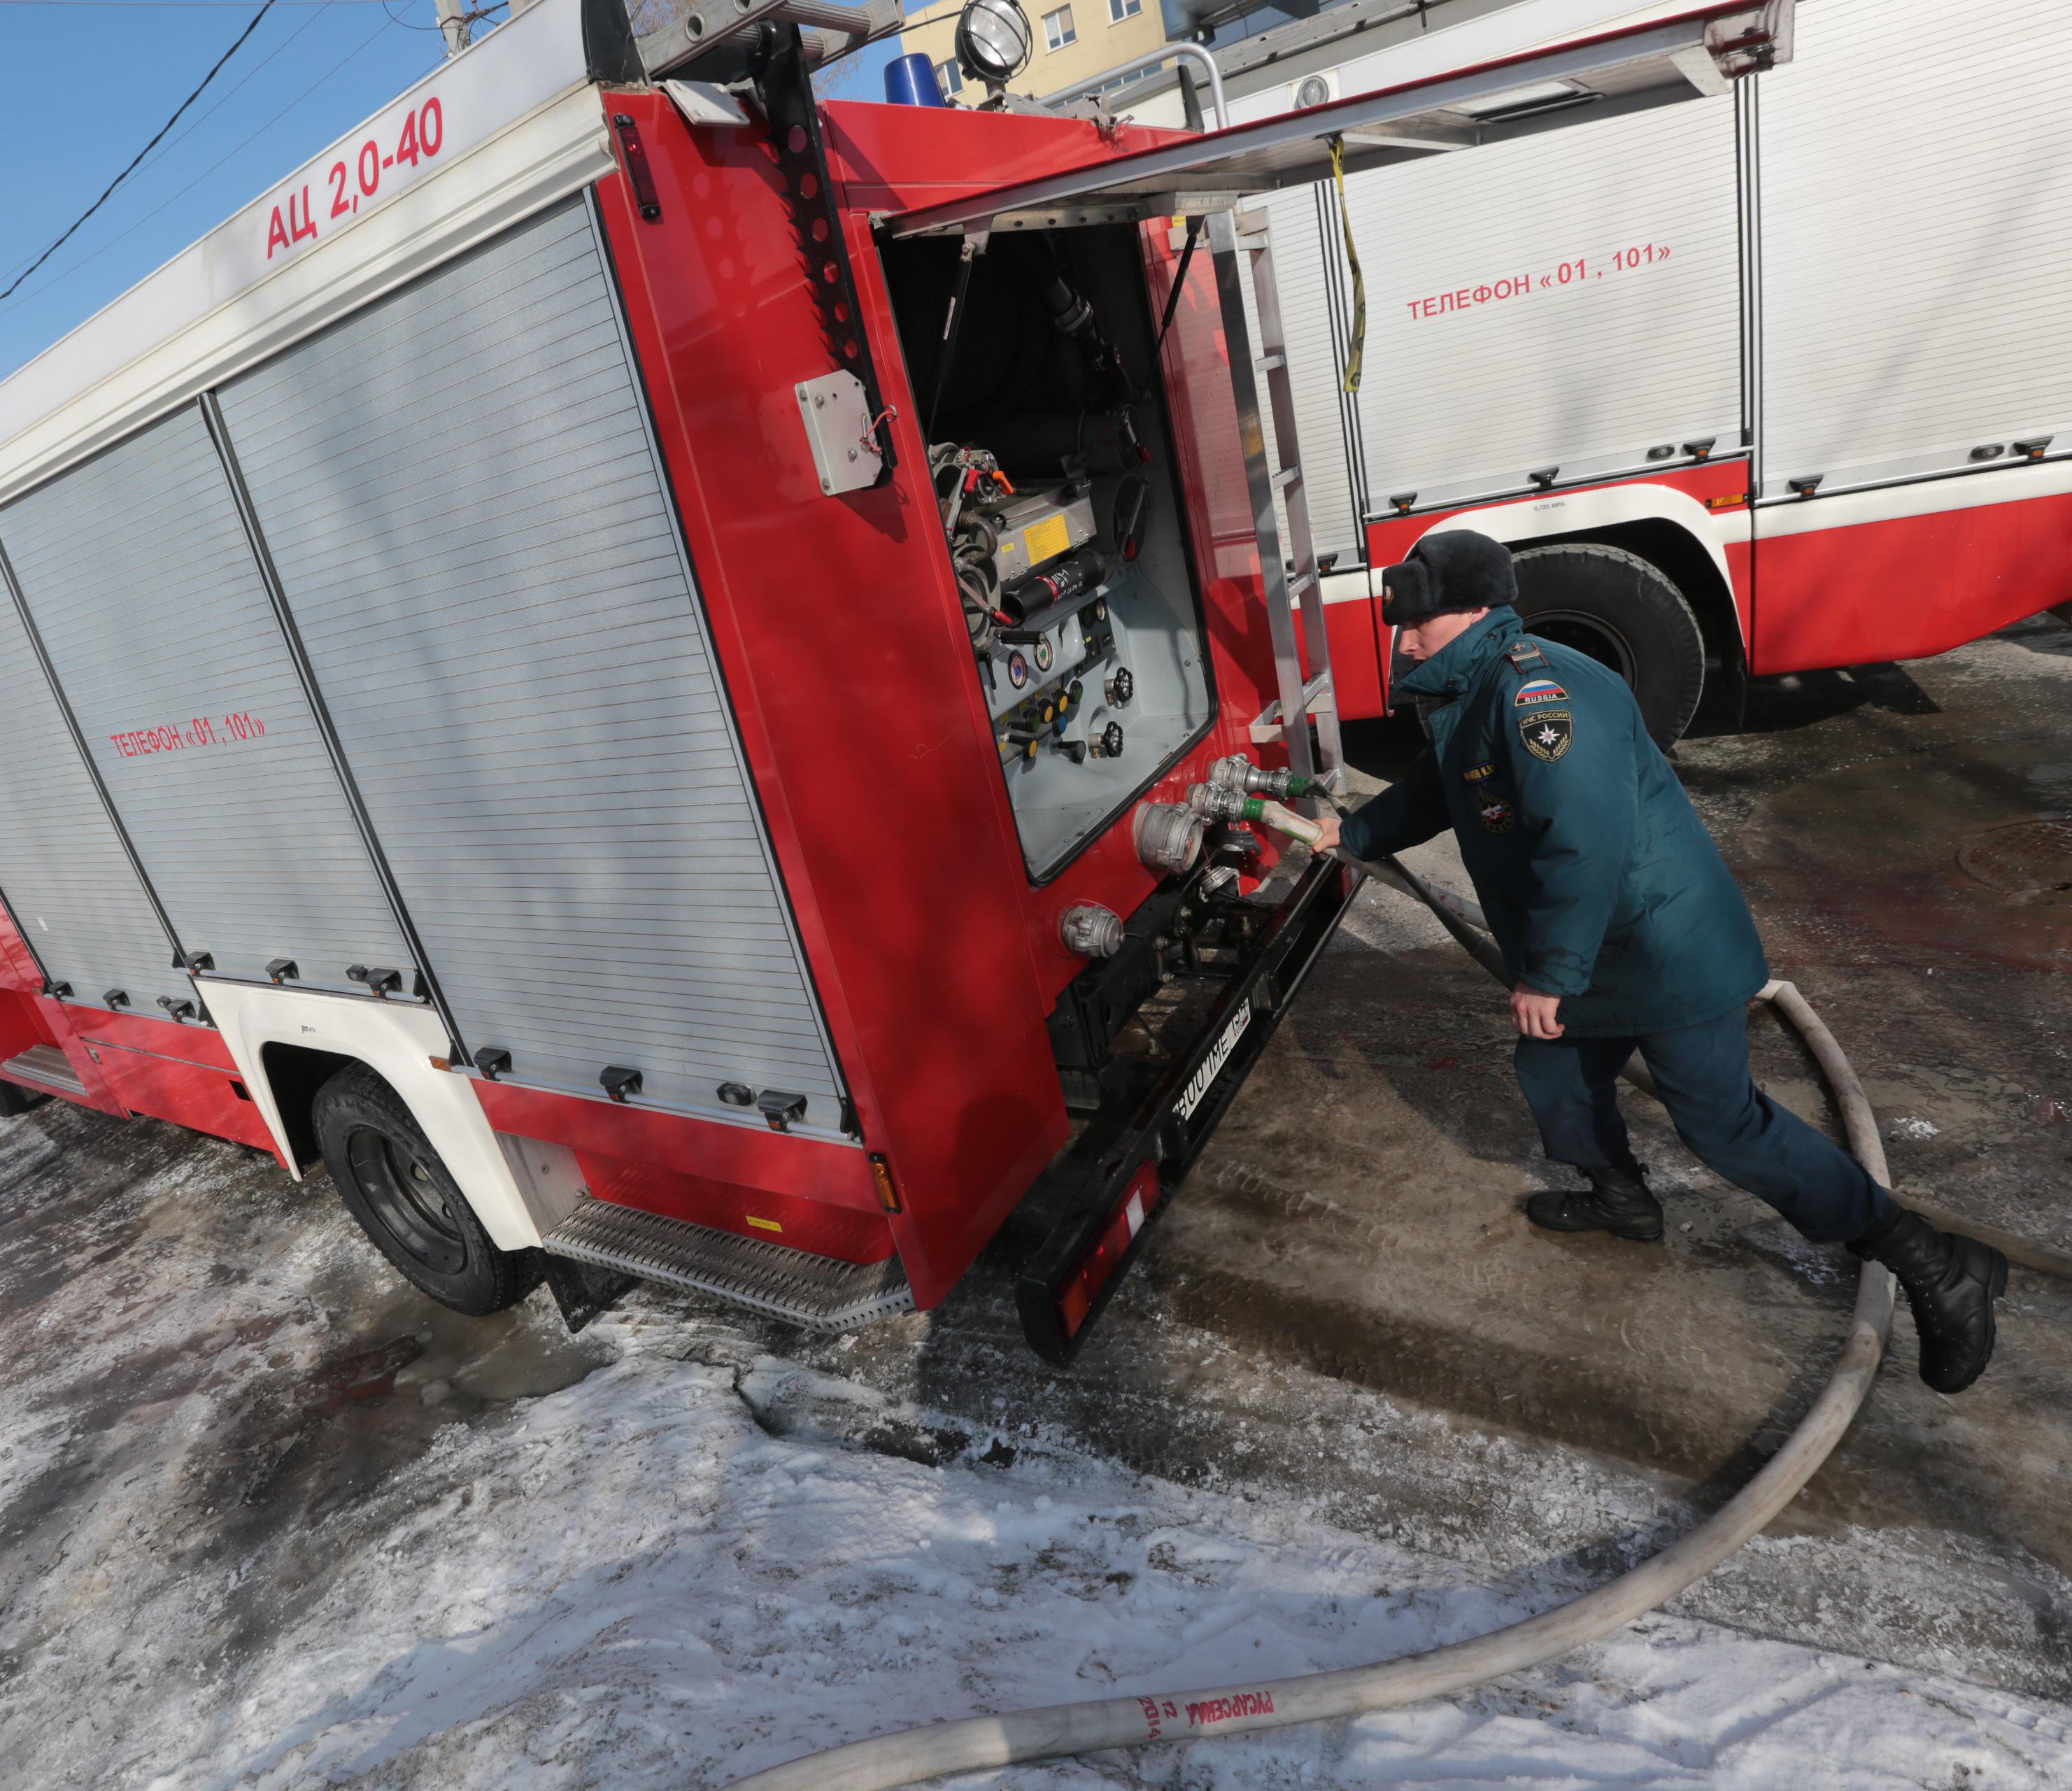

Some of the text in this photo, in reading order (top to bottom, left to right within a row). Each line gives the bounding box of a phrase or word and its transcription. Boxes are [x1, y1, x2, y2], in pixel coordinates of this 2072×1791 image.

[267, 97, 443, 260] АЦ 2,0-40
[1407, 274, 1531, 320] ТЕЛЕФОН
[1524, 693, 1558, 703] RUSSIA
[1522, 712, 1568, 725] МЧС РОССИИ
[110, 725, 185, 758] ТЕЛЕФОН
